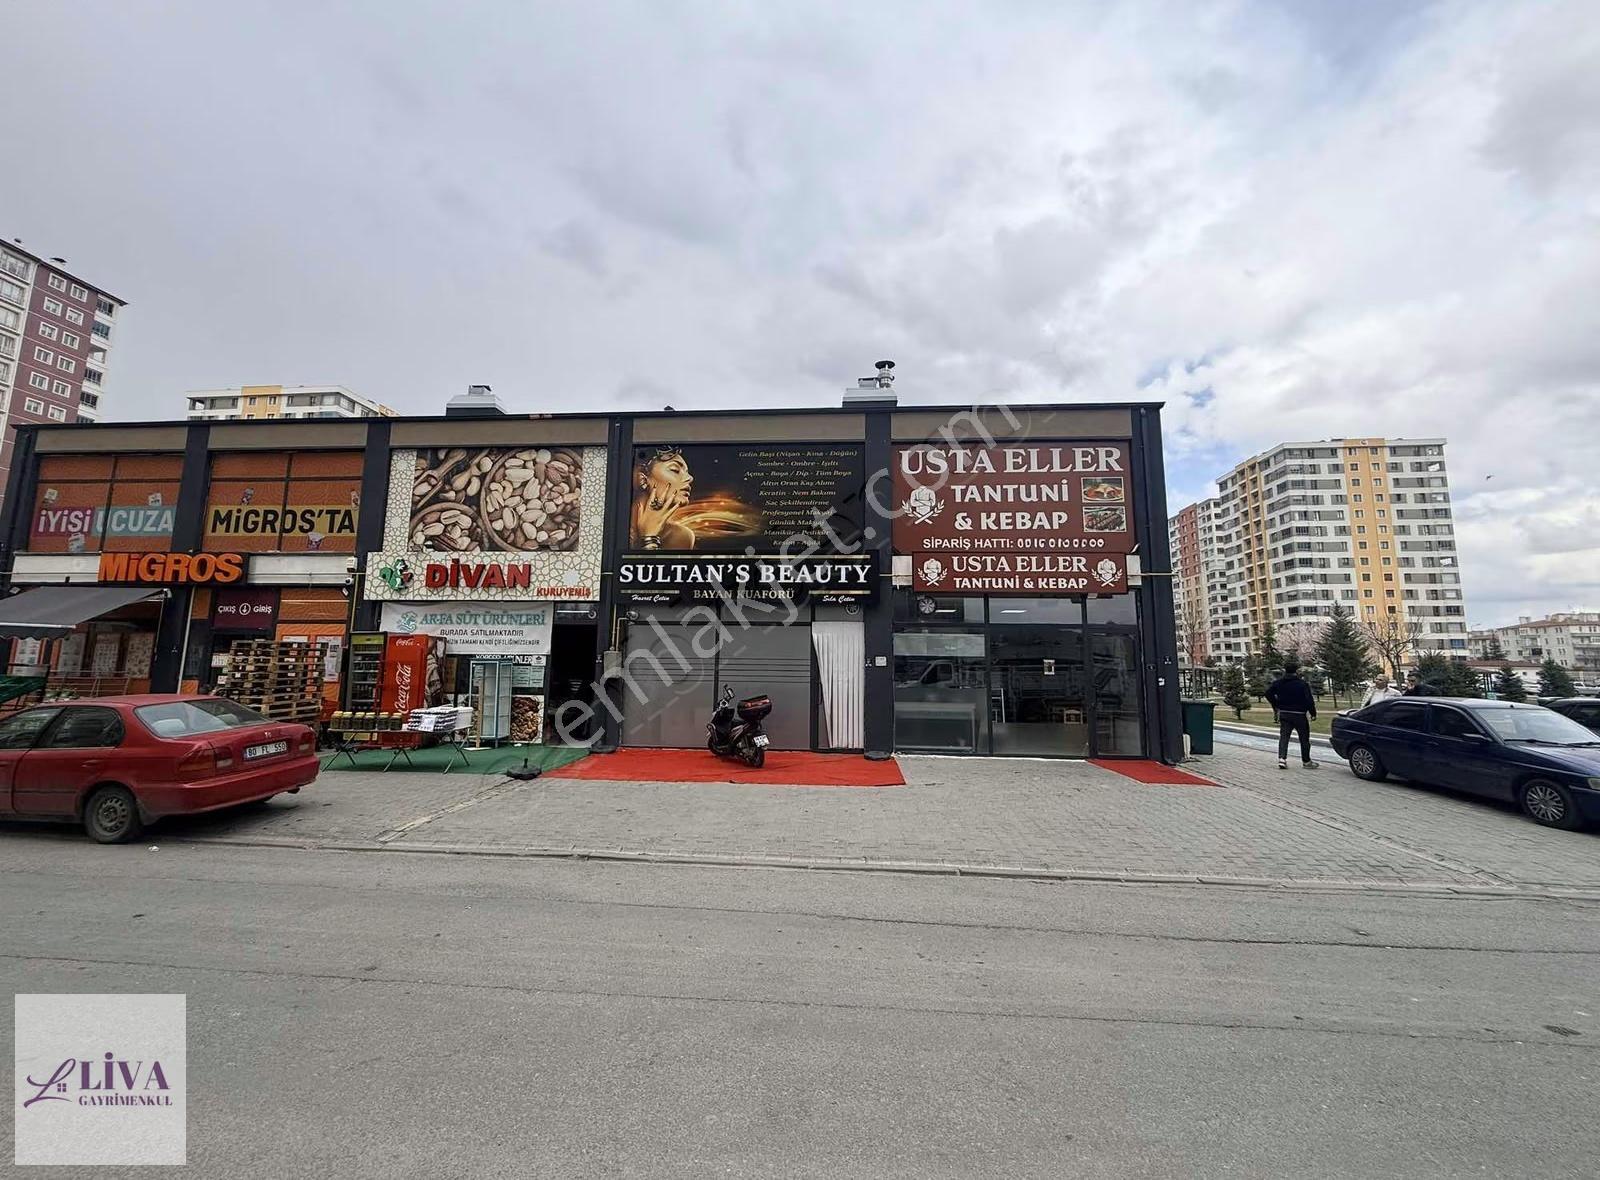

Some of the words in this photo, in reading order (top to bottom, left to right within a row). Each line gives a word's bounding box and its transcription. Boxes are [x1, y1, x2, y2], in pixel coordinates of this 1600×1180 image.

[899, 448, 996, 475] USTA
[1003, 447, 1124, 473] ELLER
[954, 513, 972, 530] &
[980, 512, 1068, 529] KEBAP
[923, 537, 971, 550] SİPARİŞ
[974, 538, 1014, 548] HATTI:
[952, 556, 1011, 572] USTA
[1015, 556, 1088, 572] ELLER
[425, 558, 532, 589] DİVAN
[759, 564, 872, 583] BEAUTY
[953, 575, 1020, 589] TANTUNİ
[1023, 578, 1034, 588] &
[1038, 578, 1088, 589] KEBAP
[536, 587, 592, 598] KURUYEMİŞ
[693, 589, 734, 599] BAYAN
[456, 611, 480, 624] SÜT
[470, 629, 524, 637] SATILMAKTADIR
